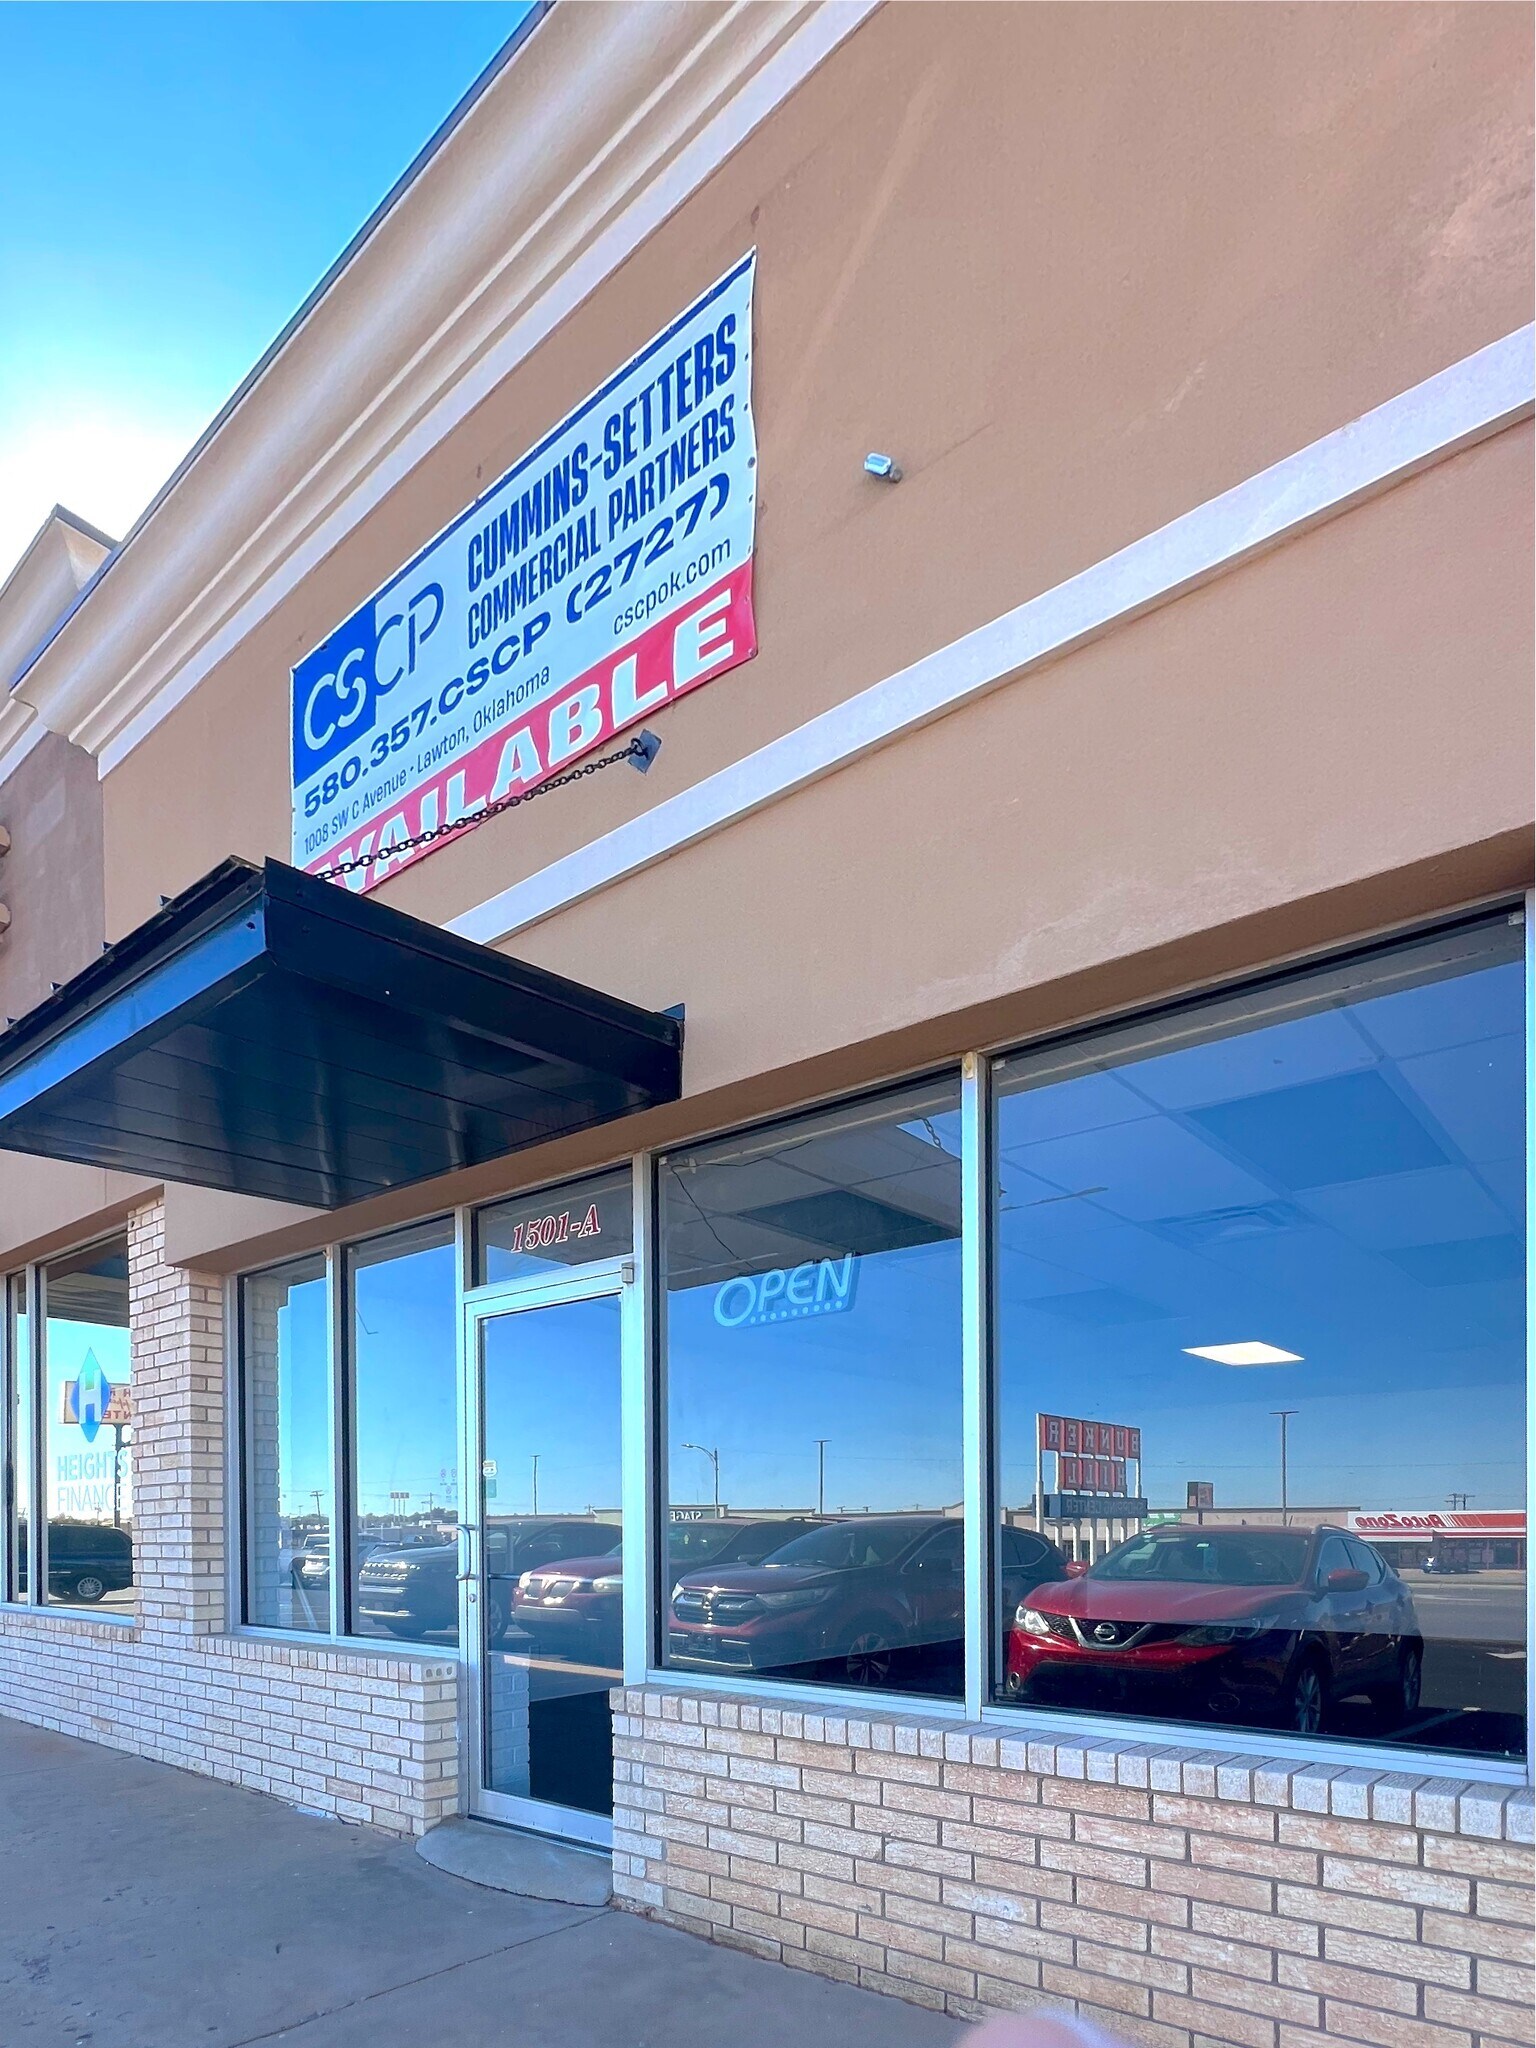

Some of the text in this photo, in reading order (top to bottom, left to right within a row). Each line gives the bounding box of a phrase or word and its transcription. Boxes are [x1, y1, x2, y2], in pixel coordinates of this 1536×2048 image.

[467, 313, 736, 593] CUMMINS-SETTERS
[467, 393, 735, 649] COMMERCIAL PARTNERS
[613, 538, 731, 635] cscpok.com
[304, 472, 730, 819] 580.357.CSCP (2727)
[304, 582, 444, 750] CSCP
[304, 666, 550, 855] 1008 SW C Avenue Lawton, Oklahoma
[510, 1203, 602, 1253] 1501-A
[713, 1251, 857, 1328] OPEN
[57, 1450, 129, 1482] HEIGHTS
[57, 1483, 128, 1512] FINANCE
